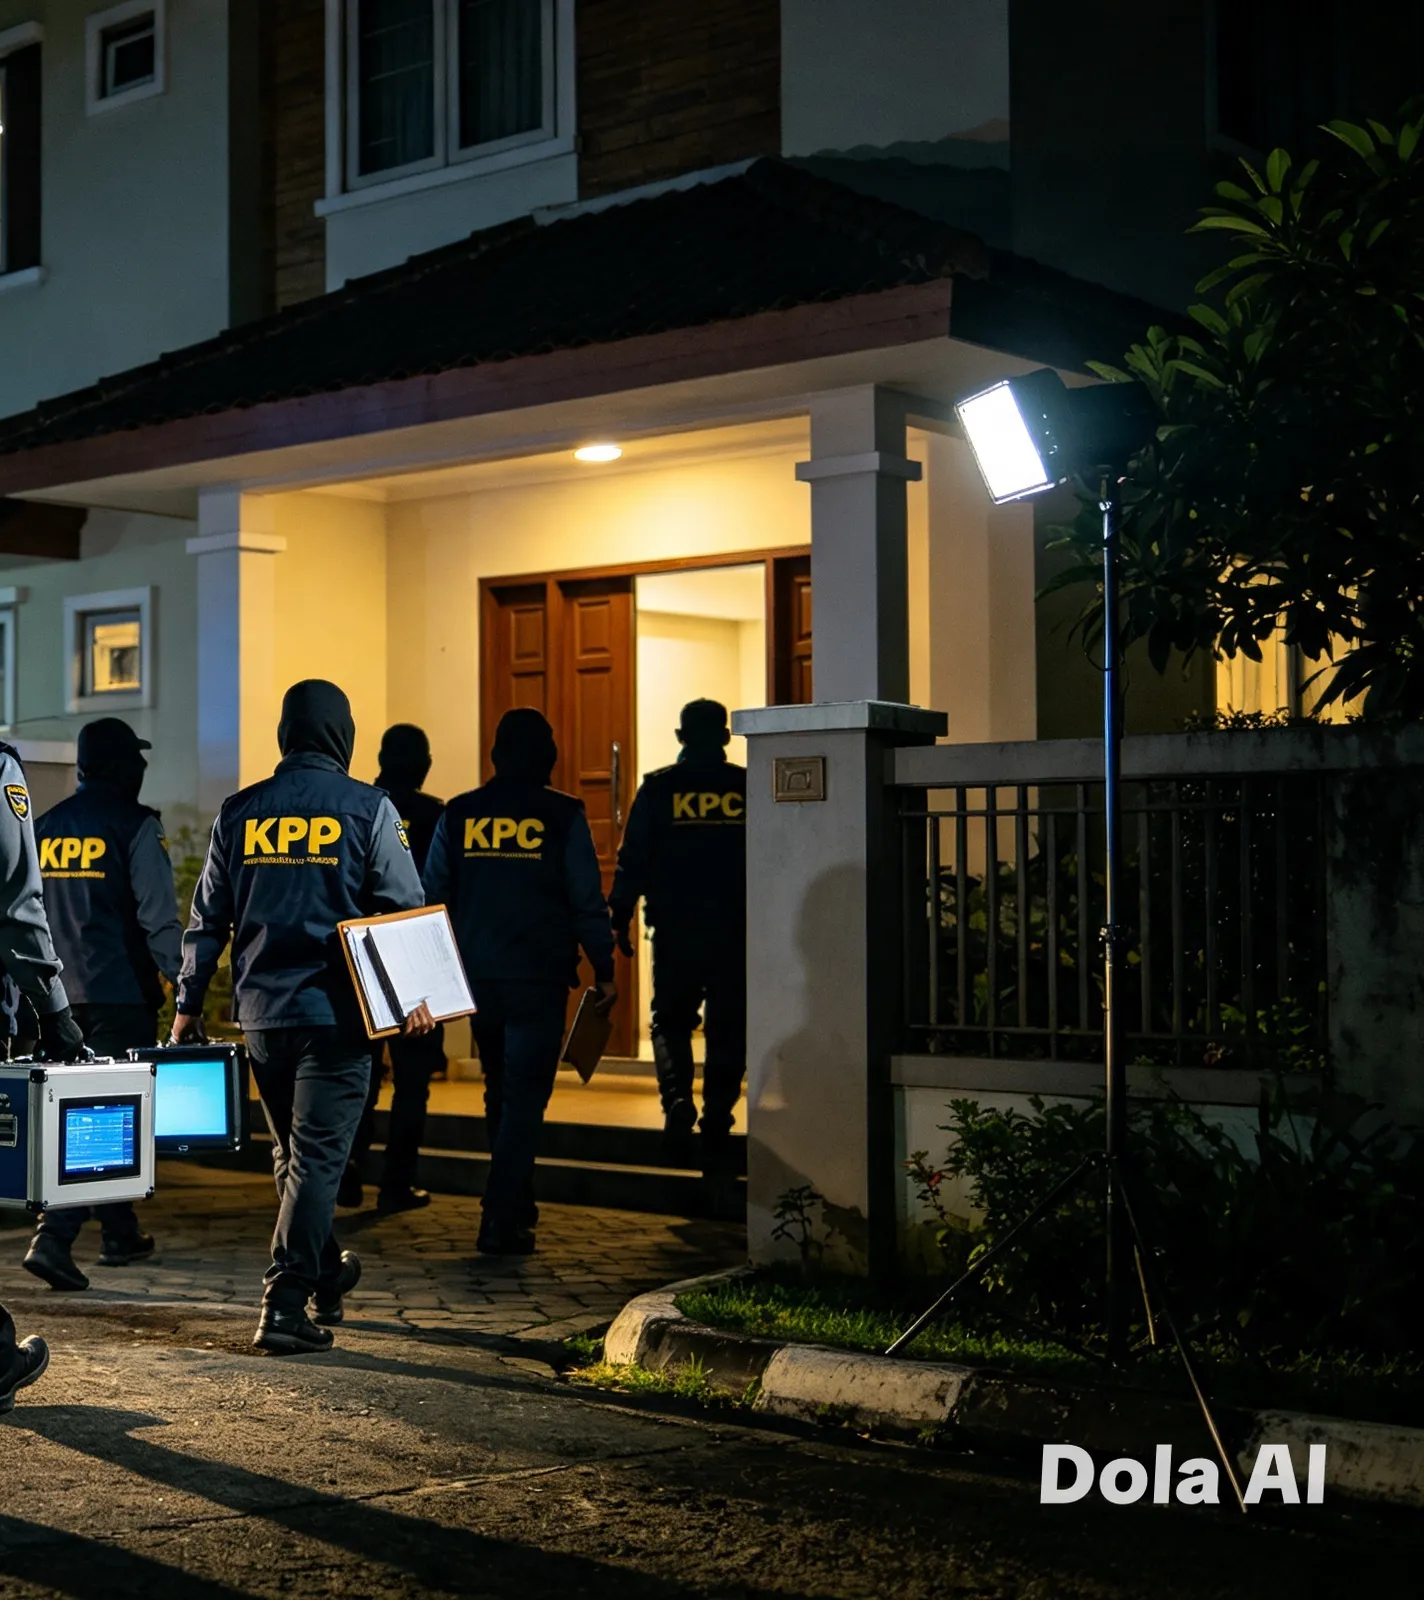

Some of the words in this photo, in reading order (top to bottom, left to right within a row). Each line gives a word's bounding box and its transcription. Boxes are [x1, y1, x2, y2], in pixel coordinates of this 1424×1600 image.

[672, 792, 744, 819] KPC
[244, 816, 343, 856] KPP
[463, 817, 545, 850] KPC
[40, 837, 107, 869] KPP
